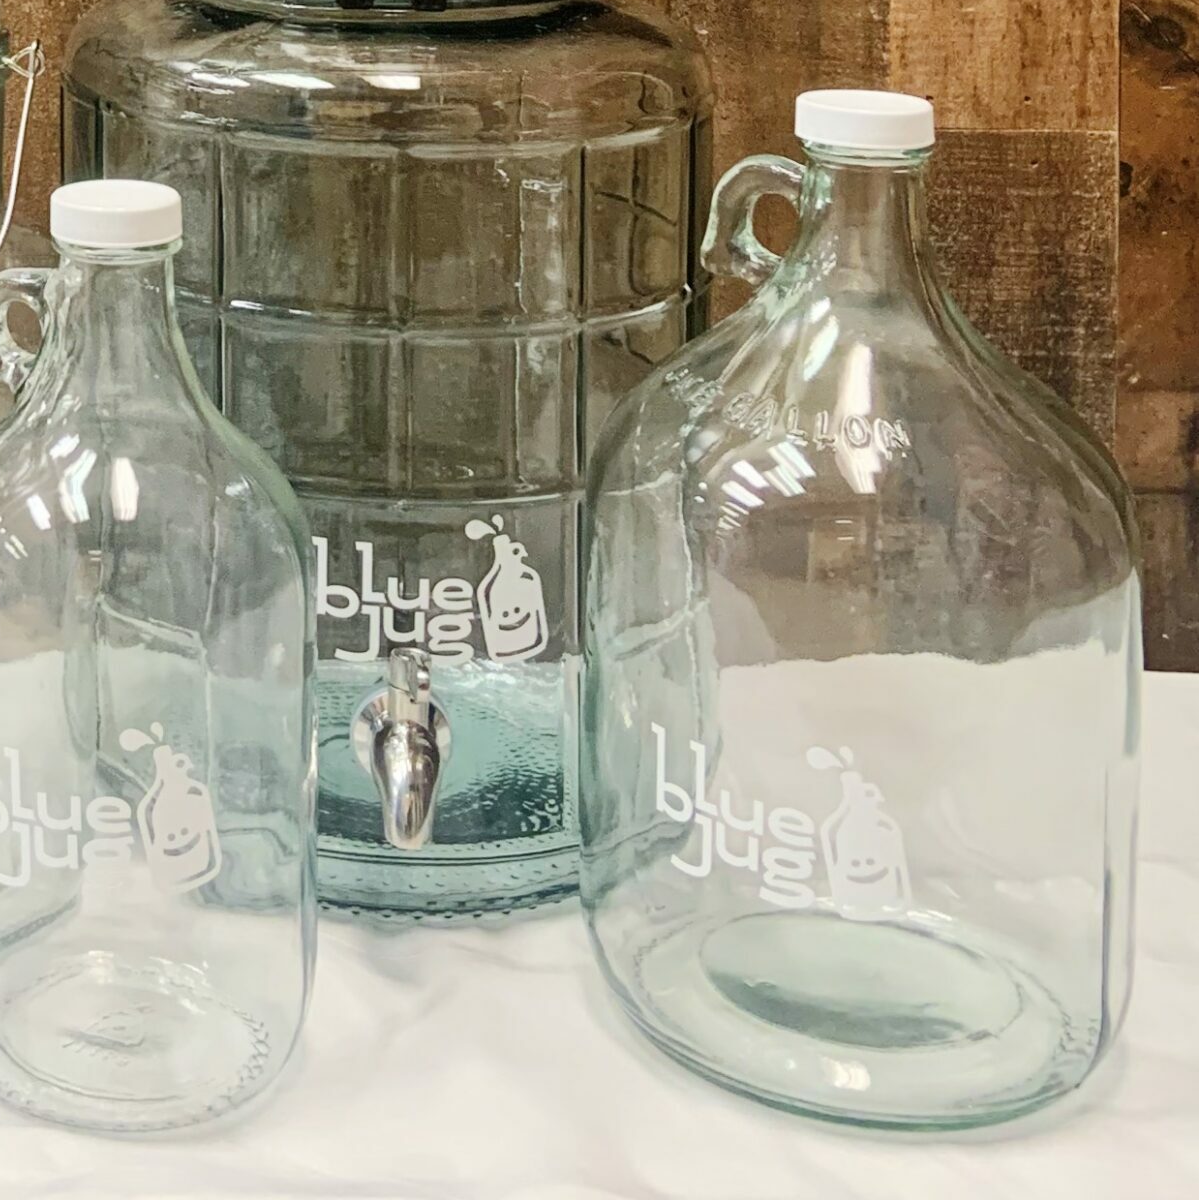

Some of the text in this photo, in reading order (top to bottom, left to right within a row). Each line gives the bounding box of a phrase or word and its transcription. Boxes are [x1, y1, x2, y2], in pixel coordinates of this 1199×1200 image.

[722, 392, 911, 460] GALLON
[311, 536, 474, 618] blue
[334, 604, 475, 665] jug
[651, 721, 816, 847] blue
[670, 812, 817, 908] jug
